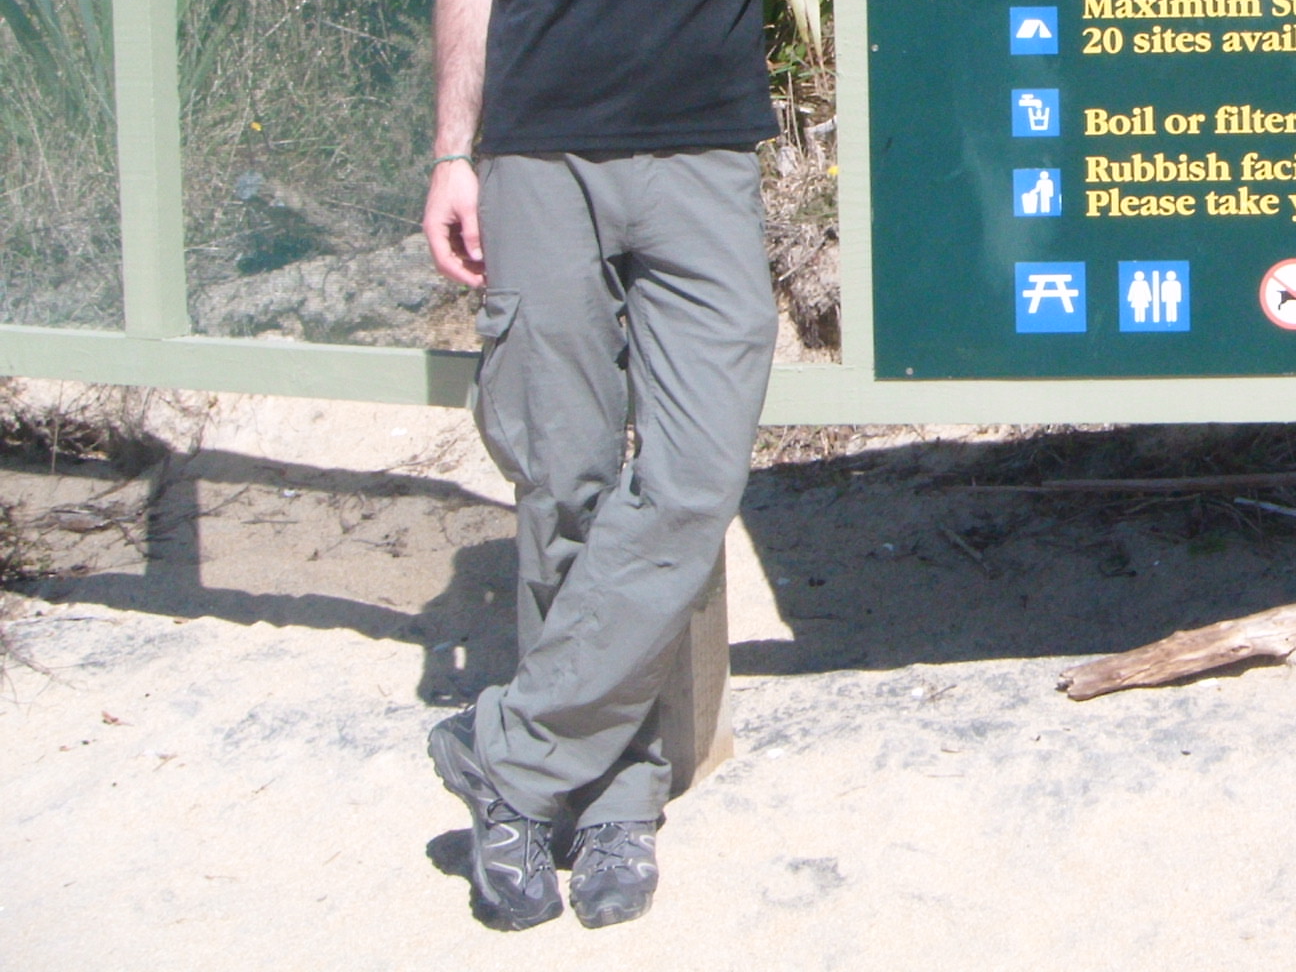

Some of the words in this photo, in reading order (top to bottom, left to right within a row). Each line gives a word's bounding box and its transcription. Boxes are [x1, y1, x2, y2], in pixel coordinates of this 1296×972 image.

[1082, 27, 1123, 54] 20
[1133, 25, 1212, 53] sites
[1084, 106, 1156, 135] Boil
[1164, 114, 1206, 134] or
[1085, 152, 1232, 183] Rubbish
[1085, 187, 1196, 217] Please
[1205, 186, 1280, 215] take
